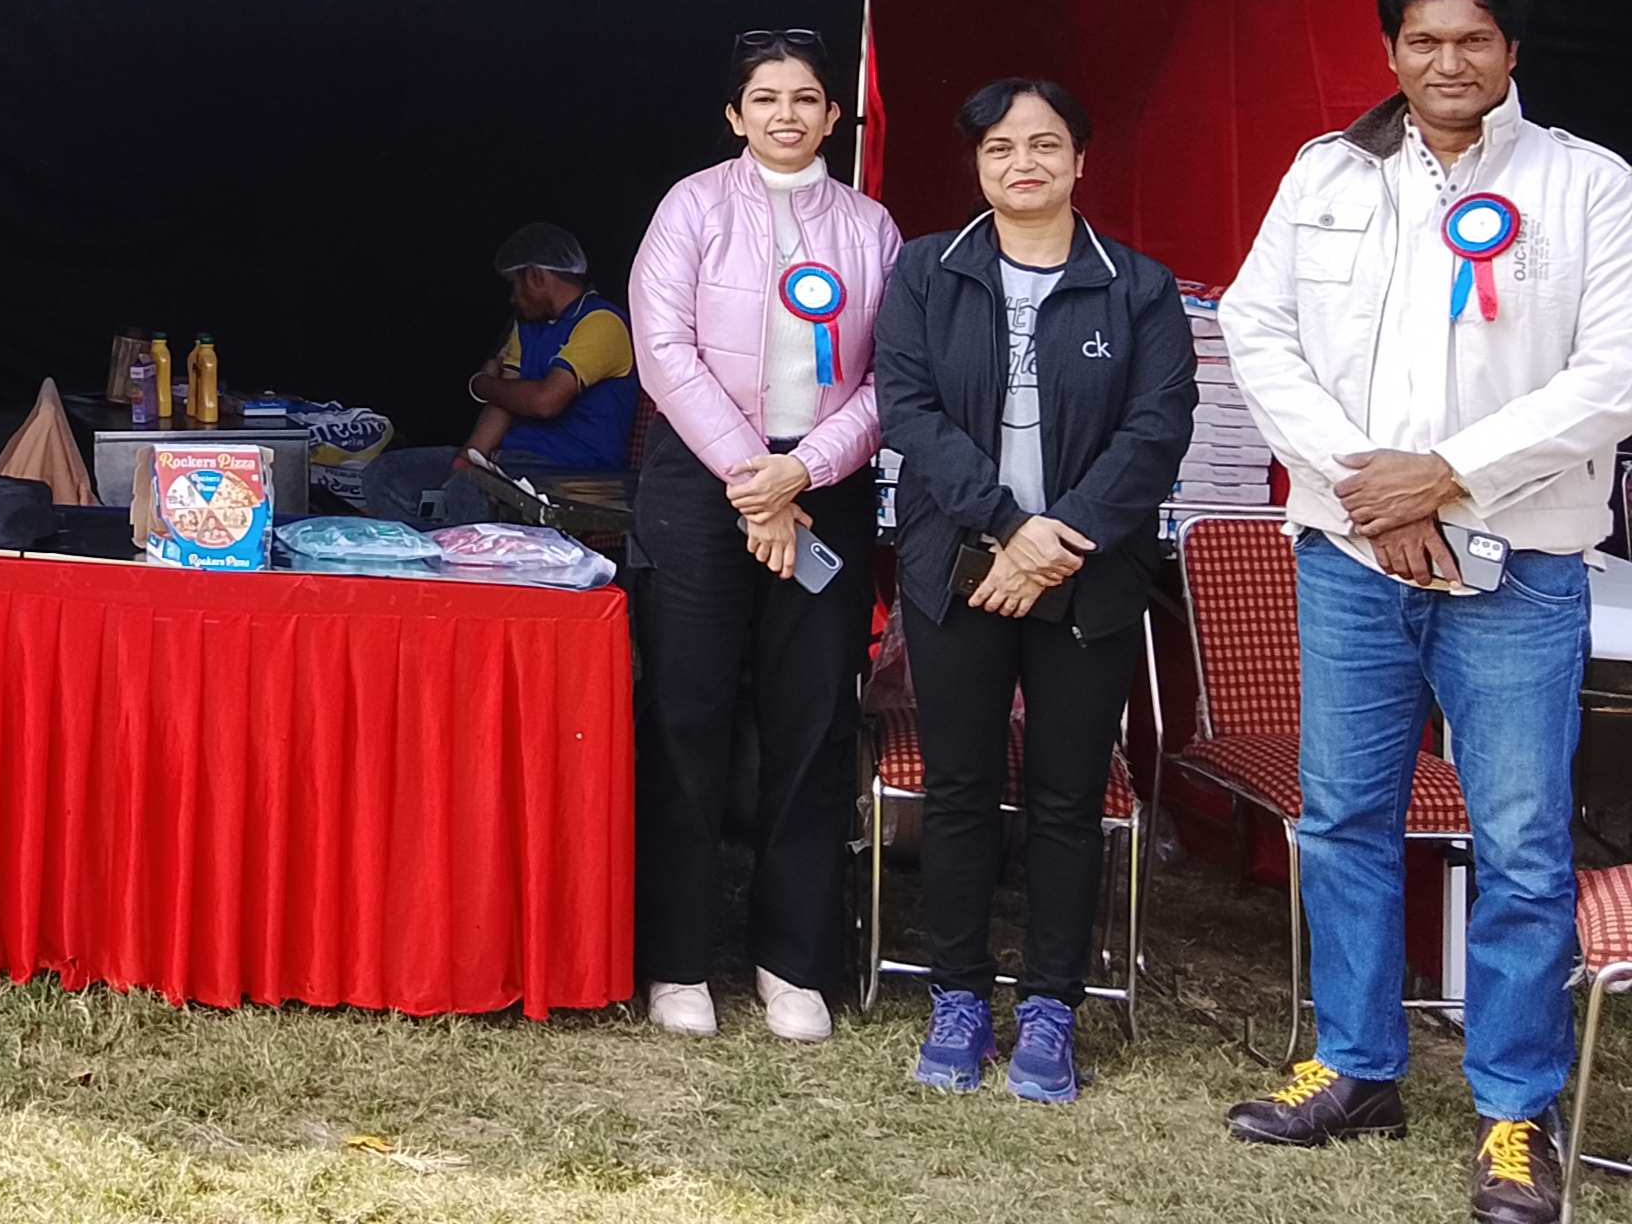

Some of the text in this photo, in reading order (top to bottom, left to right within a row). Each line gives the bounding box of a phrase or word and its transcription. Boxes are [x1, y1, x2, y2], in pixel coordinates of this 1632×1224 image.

[1081, 330, 1113, 359] ck
[159, 452, 256, 470] Rockers Pizza
